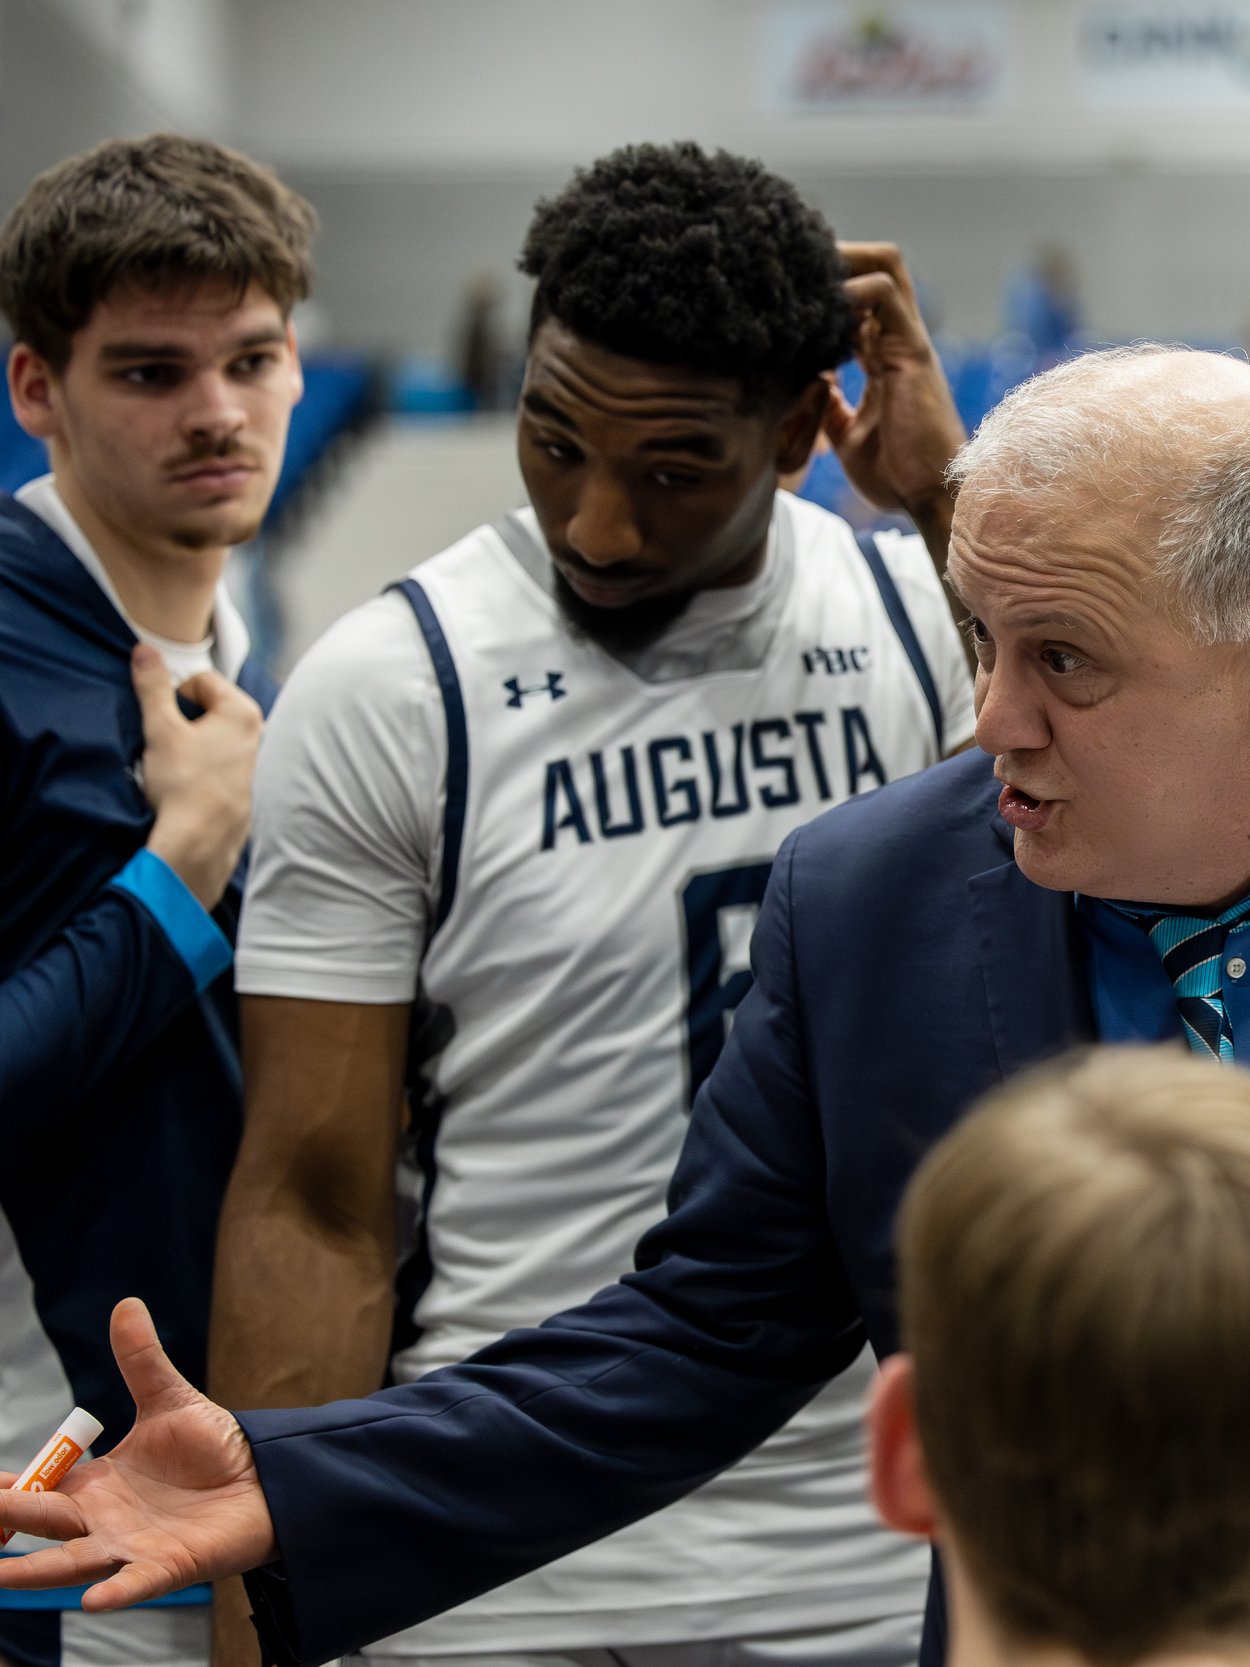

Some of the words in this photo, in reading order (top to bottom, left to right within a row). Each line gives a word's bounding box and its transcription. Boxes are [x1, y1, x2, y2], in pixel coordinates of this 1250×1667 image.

[802, 646, 869, 676] PBC
[540, 706, 887, 851] AUGUSTA
[41, 1463, 55, 1477] low
[54, 1446, 69, 1464] odor
